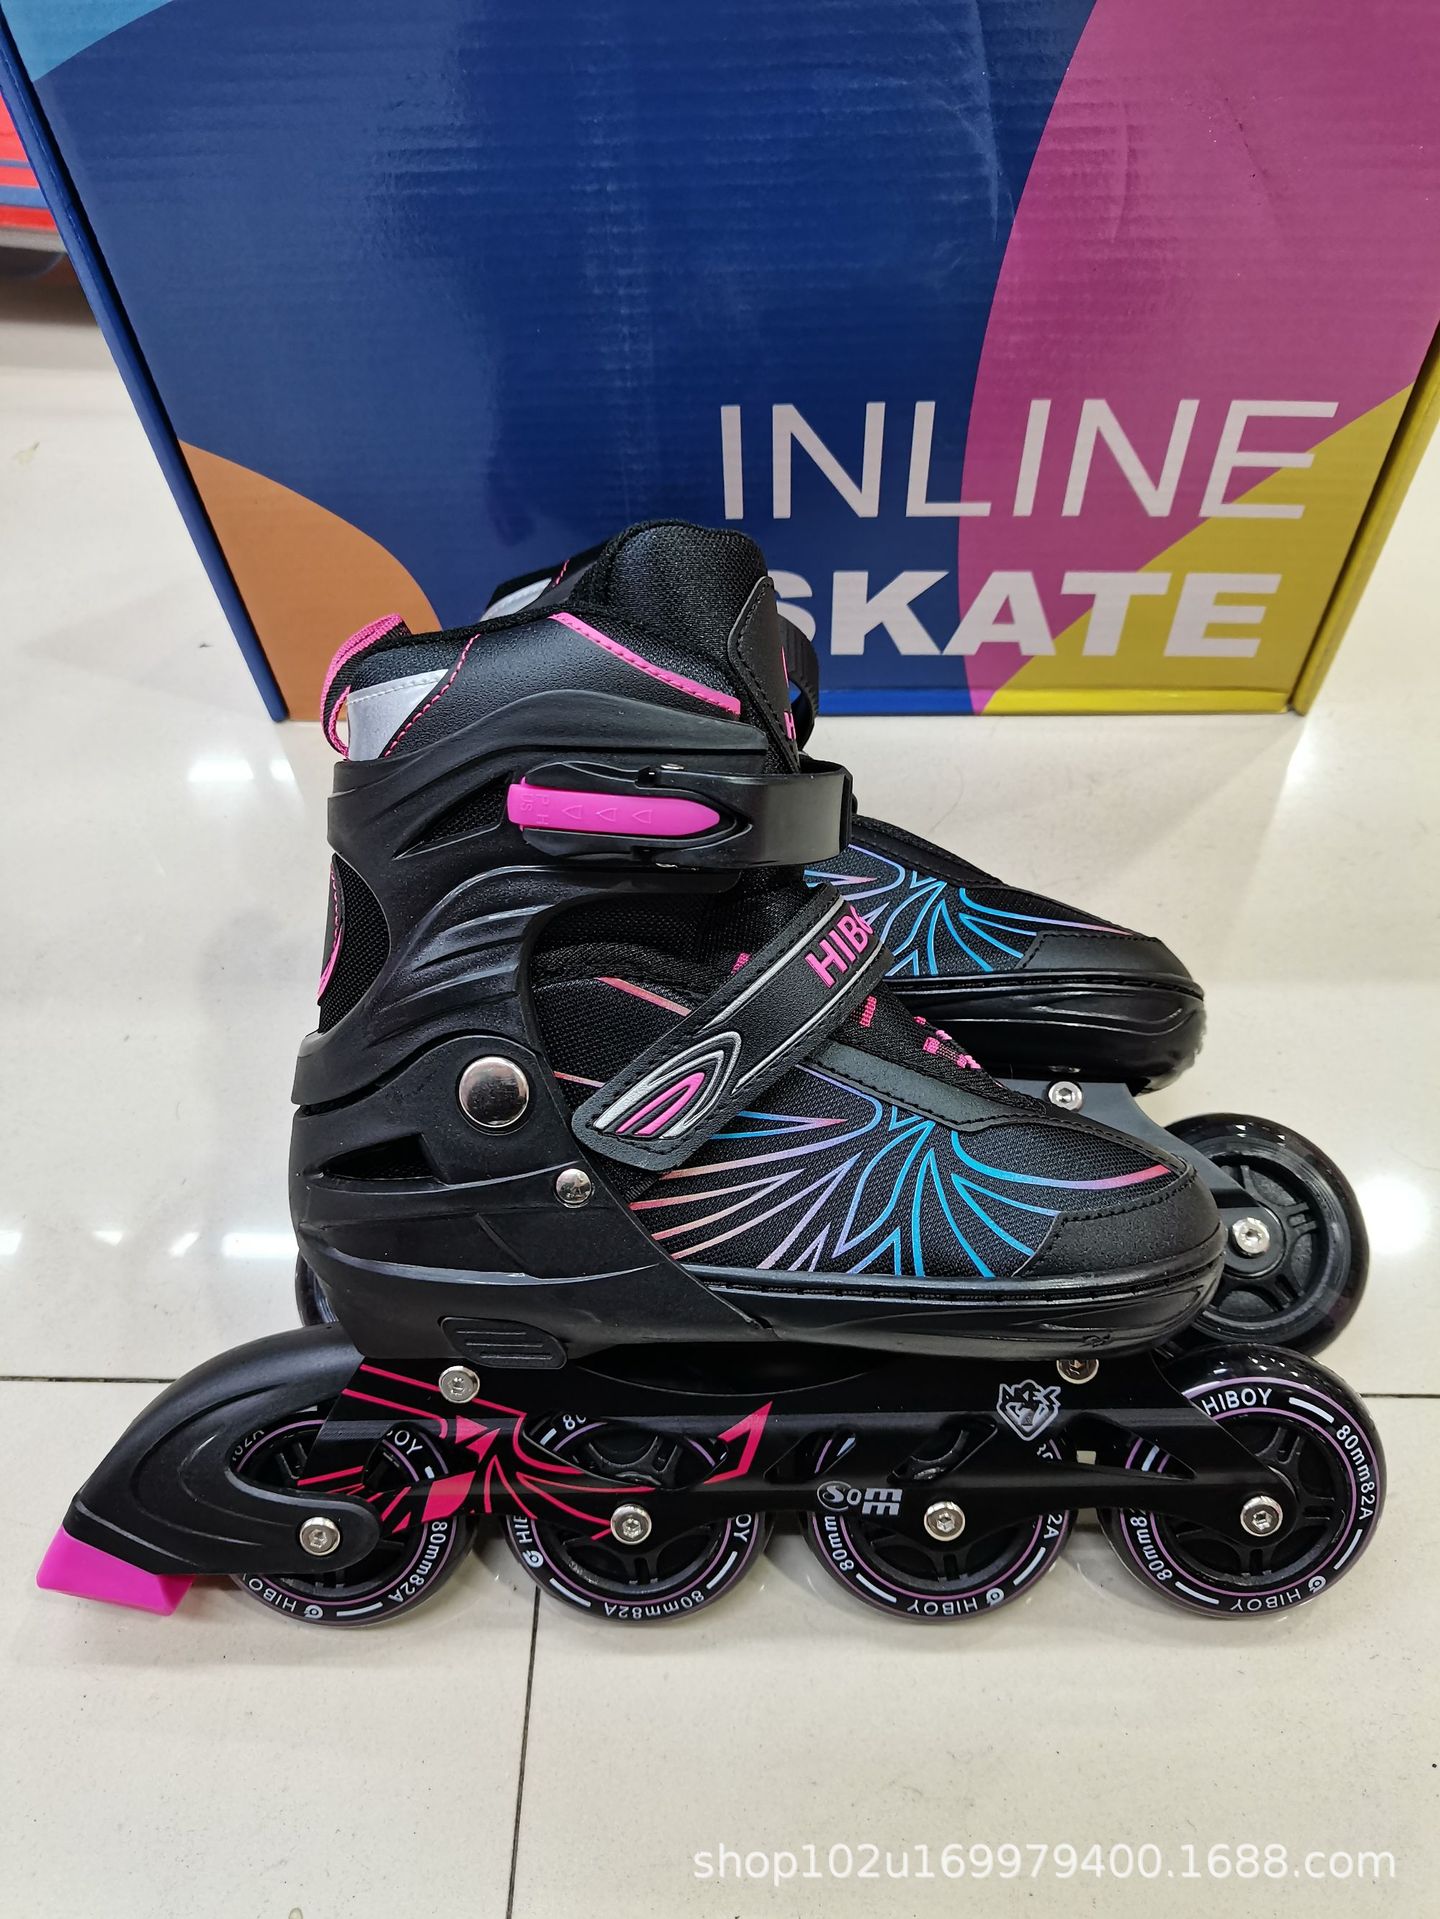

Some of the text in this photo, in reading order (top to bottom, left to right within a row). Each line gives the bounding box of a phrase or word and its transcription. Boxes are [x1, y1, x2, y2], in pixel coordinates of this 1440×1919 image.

[720, 400, 1339, 520] INLINE
[1202, 1388, 1272, 1415] HIBOY
[1336, 1424, 1376, 1520] 80mm82A
[388, 1520, 448, 1603] 80mm82A
[603, 1590, 705, 1620] 80mm82A
[907, 1598, 978, 1616] HIBOY
[1230, 1587, 1302, 1612] HIBOY
